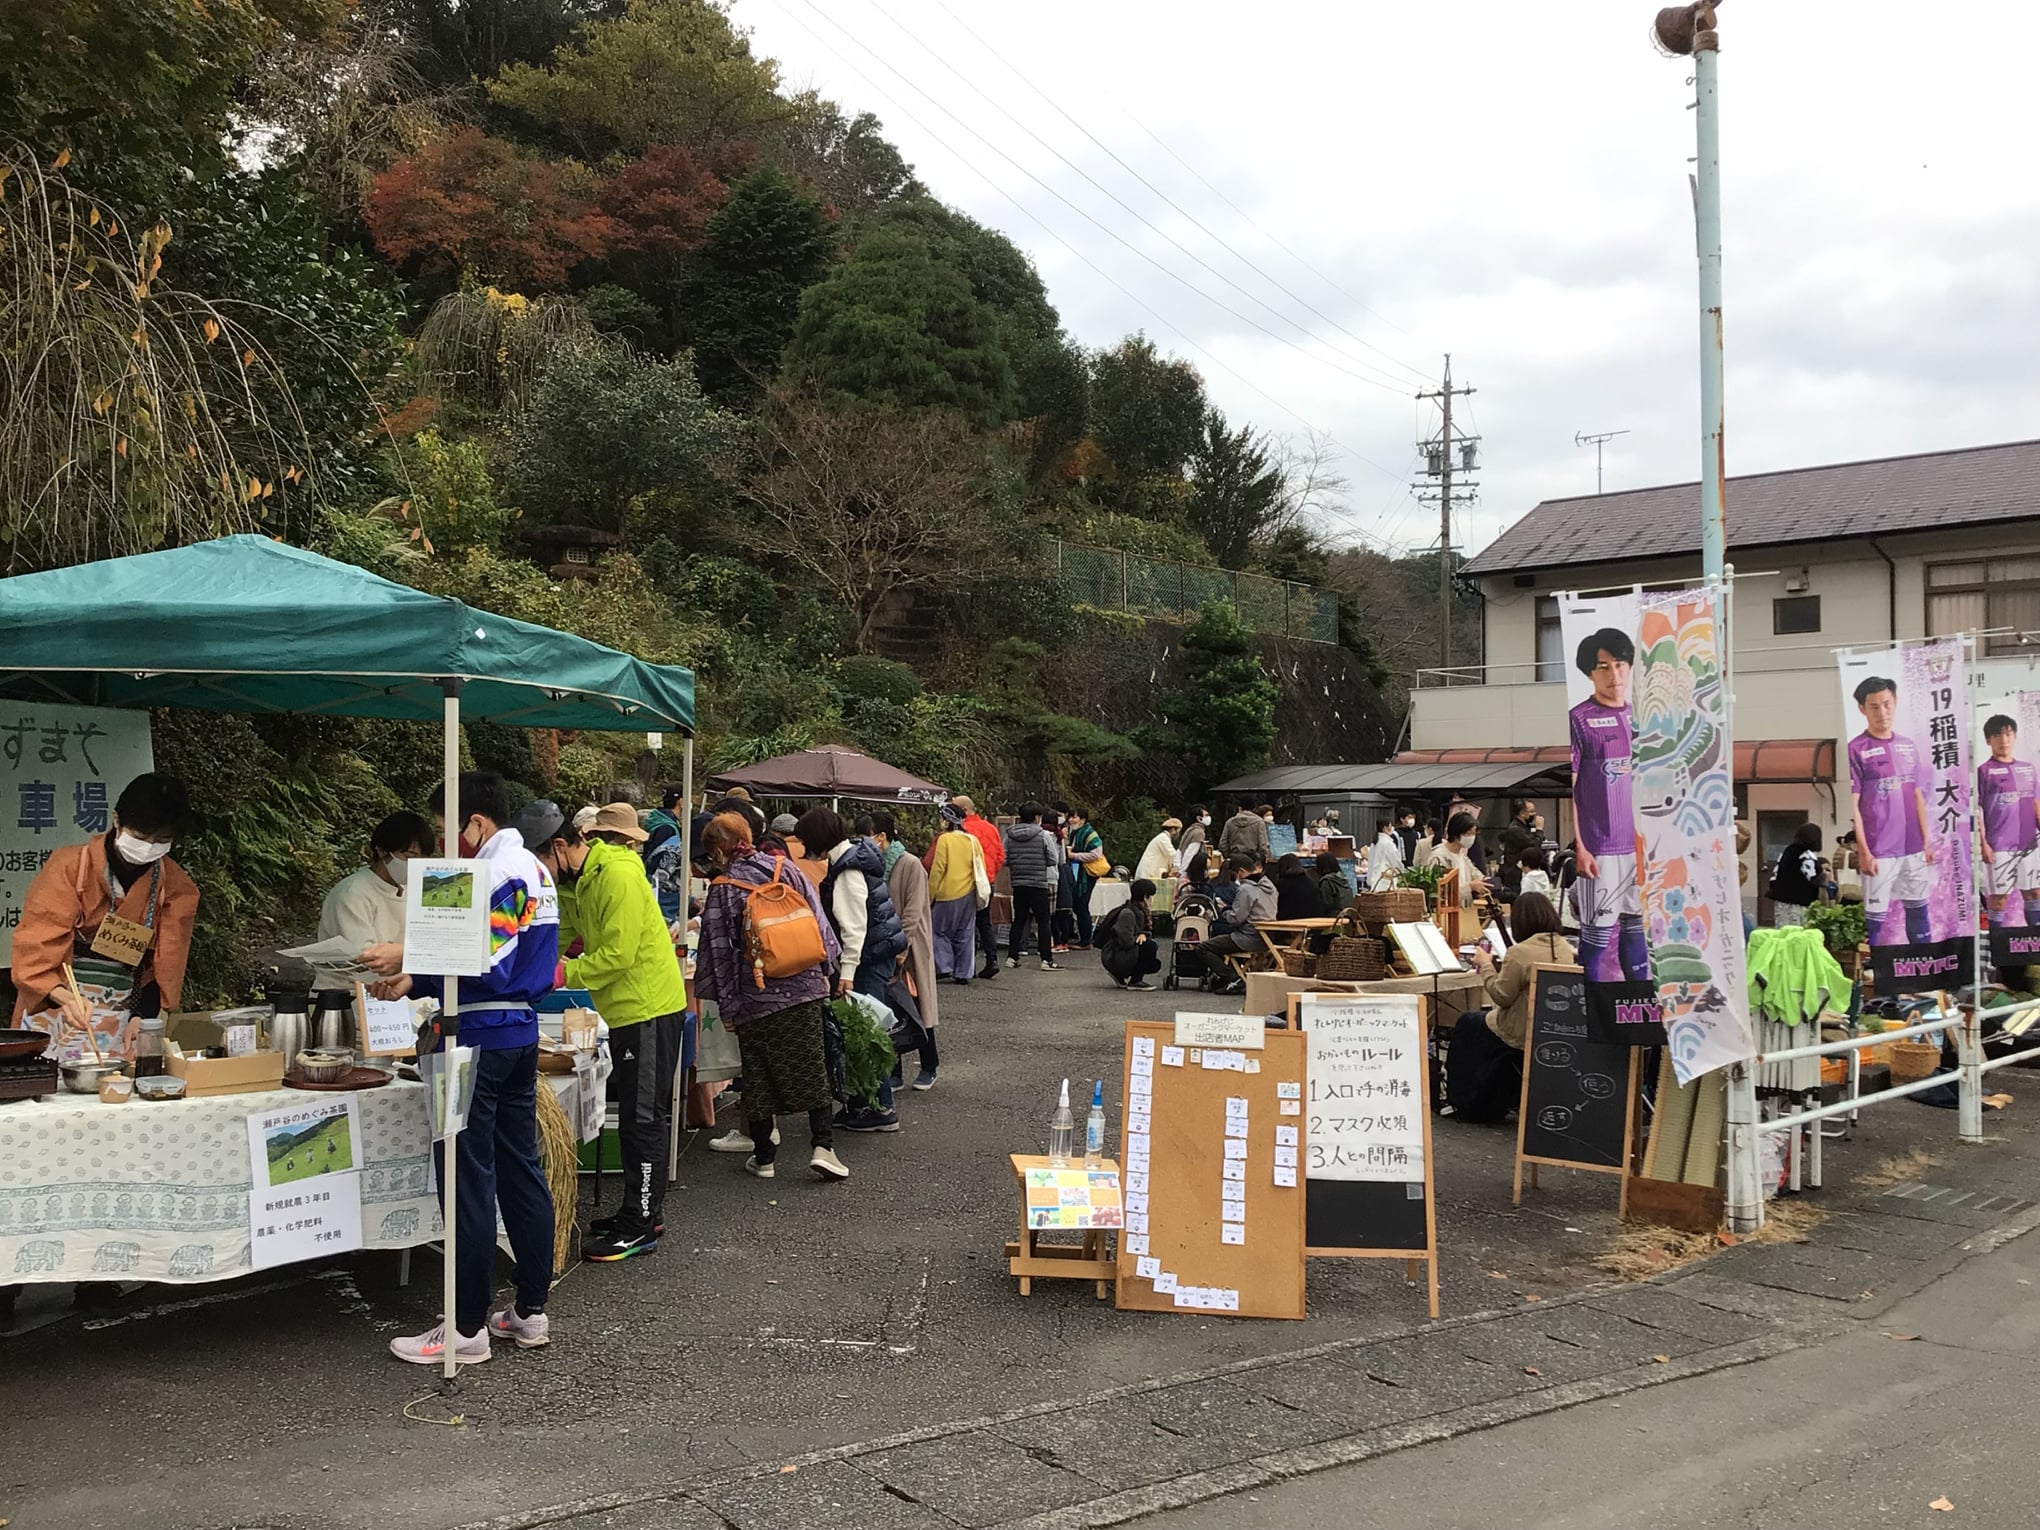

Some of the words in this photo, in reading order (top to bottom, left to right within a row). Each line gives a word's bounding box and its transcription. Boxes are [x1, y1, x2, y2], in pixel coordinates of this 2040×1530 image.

[1930, 687, 1952, 712] 19
[1929, 714, 1961, 771] 稲積
[0, 779, 109, 834] 車場
[1935, 778, 1962, 835] 大介
[0, 849, 54, 872] お客様
[1955, 880, 1967, 922] INAZUMI
[2009, 941, 2040, 953] MY
[1893, 955, 1959, 977] MYFC
[1615, 1004, 1662, 1024] MY
[1183, 1021, 1257, 1034] オーガニックマーケット
[1194, 1032, 1246, 1044] 出店者MAP
[262, 1102, 348, 1129] 瀬戸谷のめぐみ茶園
[256, 1216, 323, 1238] 農薬・化学肥料
[314, 1230, 342, 1243] 不使用
